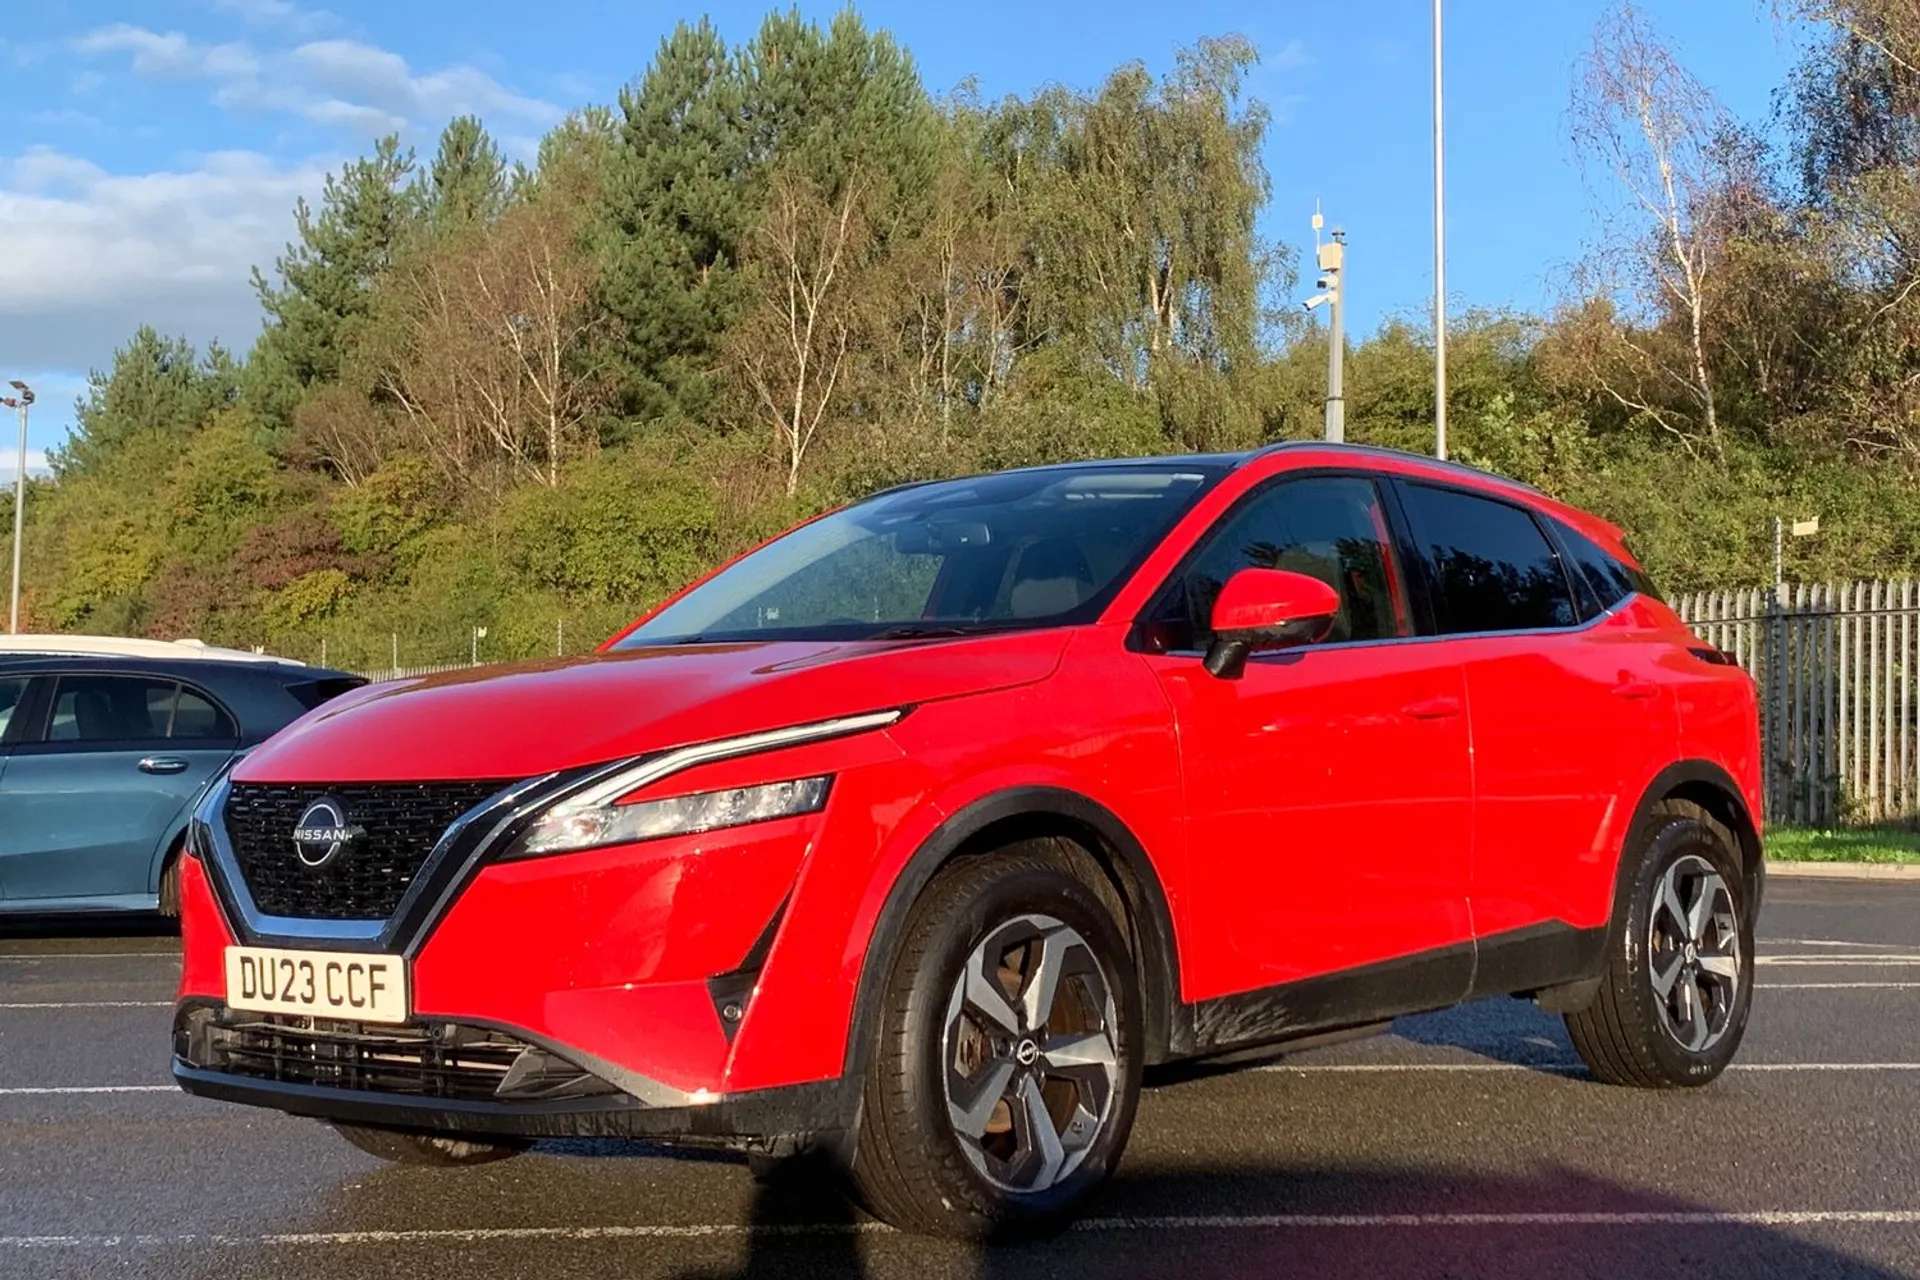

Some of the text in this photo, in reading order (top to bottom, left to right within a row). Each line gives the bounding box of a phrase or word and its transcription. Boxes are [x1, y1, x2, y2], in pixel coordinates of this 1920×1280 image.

[293, 829, 346, 840] NISSAN
[240, 956, 387, 1009] DU23 CCF
